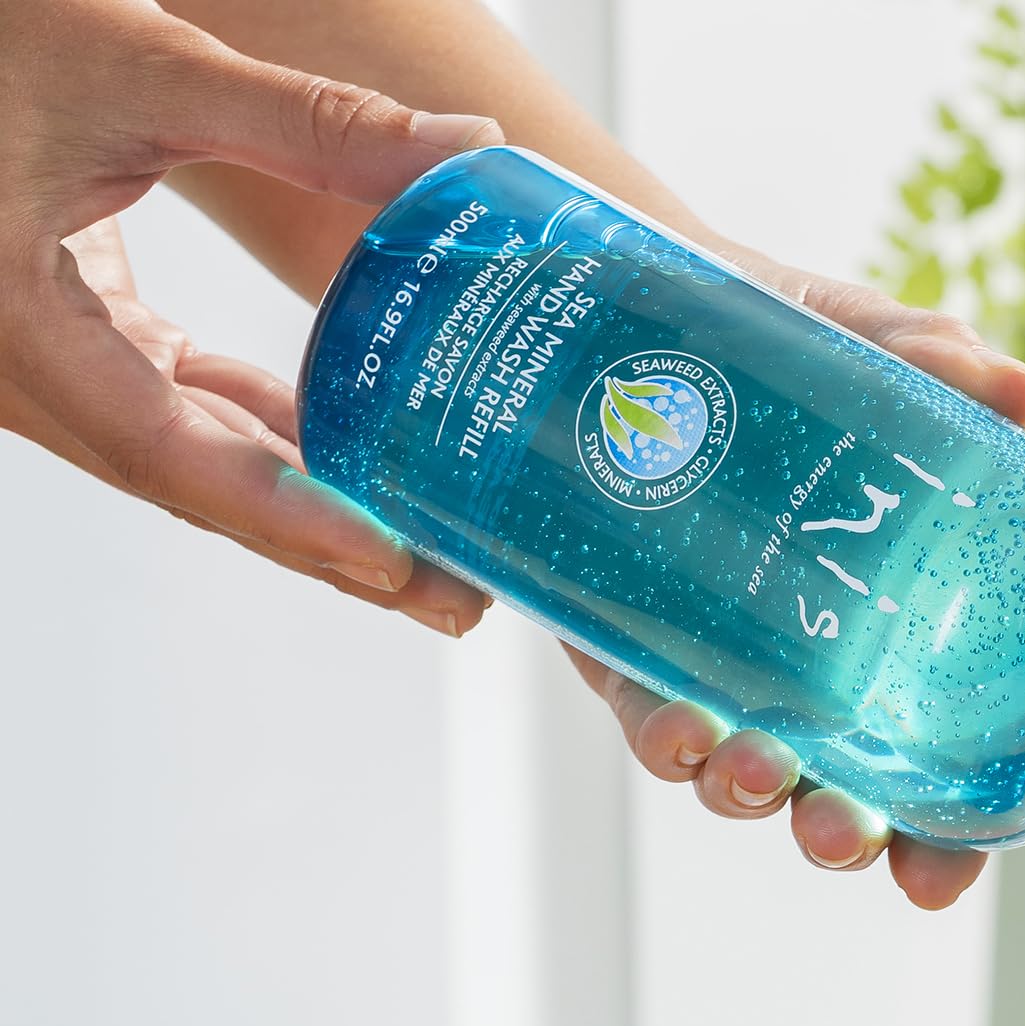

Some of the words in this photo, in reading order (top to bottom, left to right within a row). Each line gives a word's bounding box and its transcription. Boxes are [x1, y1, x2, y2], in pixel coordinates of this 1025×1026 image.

[492, 233, 526, 264] AUX
[435, 262, 499, 347] MINÉRAUX
[462, 257, 528, 337] RECHARGE
[522, 283, 542, 306] with
[539, 256, 602, 313] HAND
[490, 305, 524, 354] seaweed
[553, 291, 596, 329] SEA
[422, 347, 443, 372] DE
[431, 338, 469, 399] SAVON
[490, 315, 549, 386] WASH
[632, 358, 703, 380] SEAWEED
[406, 372, 431, 410] MER
[464, 352, 492, 399] extracts
[492, 332, 564, 434] MINERAL
[458, 386, 501, 460] REFILL
[700, 376, 727, 445] EXTRACTS
[584, 432, 633, 497] MINERALS
[832, 431, 857, 457] the
[645, 456, 709, 500] GLYCERIN
[789, 456, 832, 511] energy
[761, 533, 782, 565] the
[775, 512, 792, 539] of
[747, 565, 765, 596] sea
